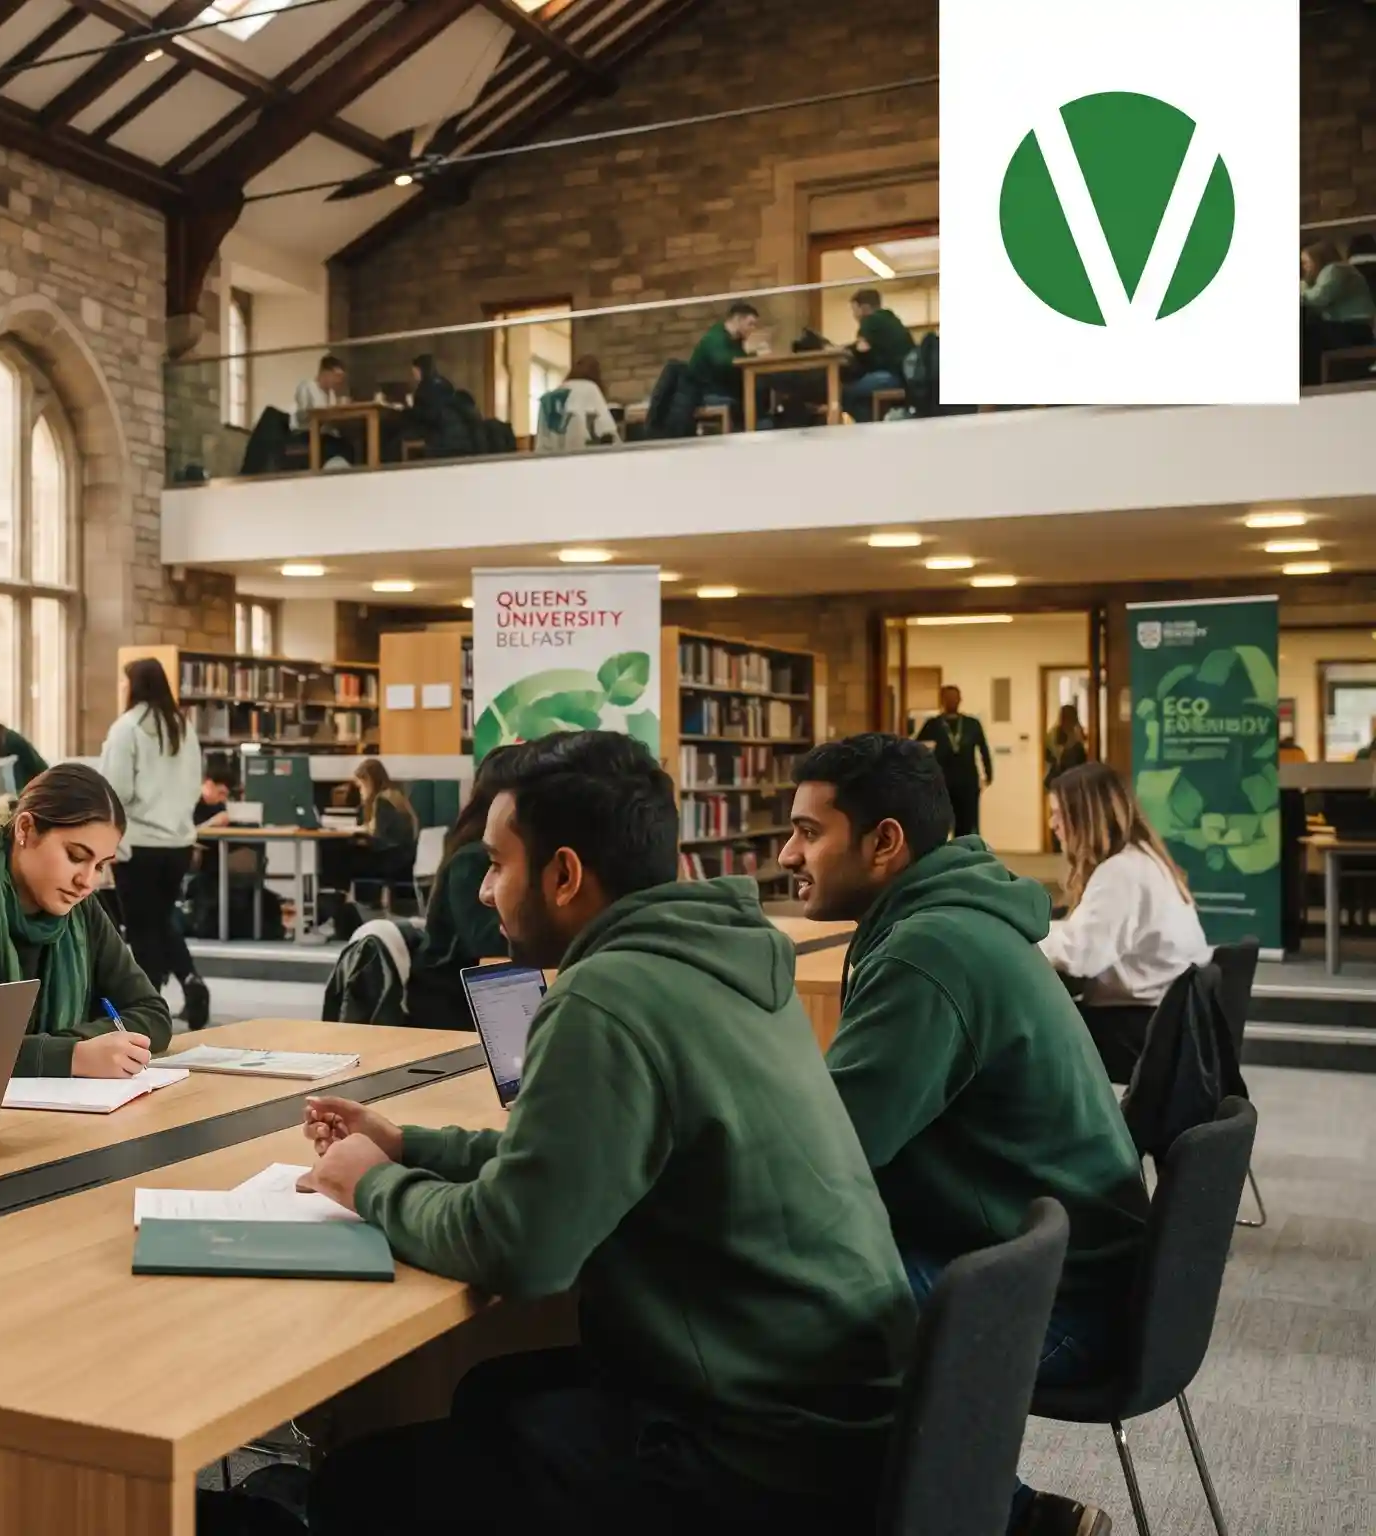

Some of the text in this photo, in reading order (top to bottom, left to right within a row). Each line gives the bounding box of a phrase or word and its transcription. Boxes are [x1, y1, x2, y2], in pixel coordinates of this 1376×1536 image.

[496, 590, 587, 610] QUEEN'S
[497, 610, 624, 628] UNIVERSITY
[496, 630, 576, 647] BELFAST
[1163, 696, 1209, 716] ECO
